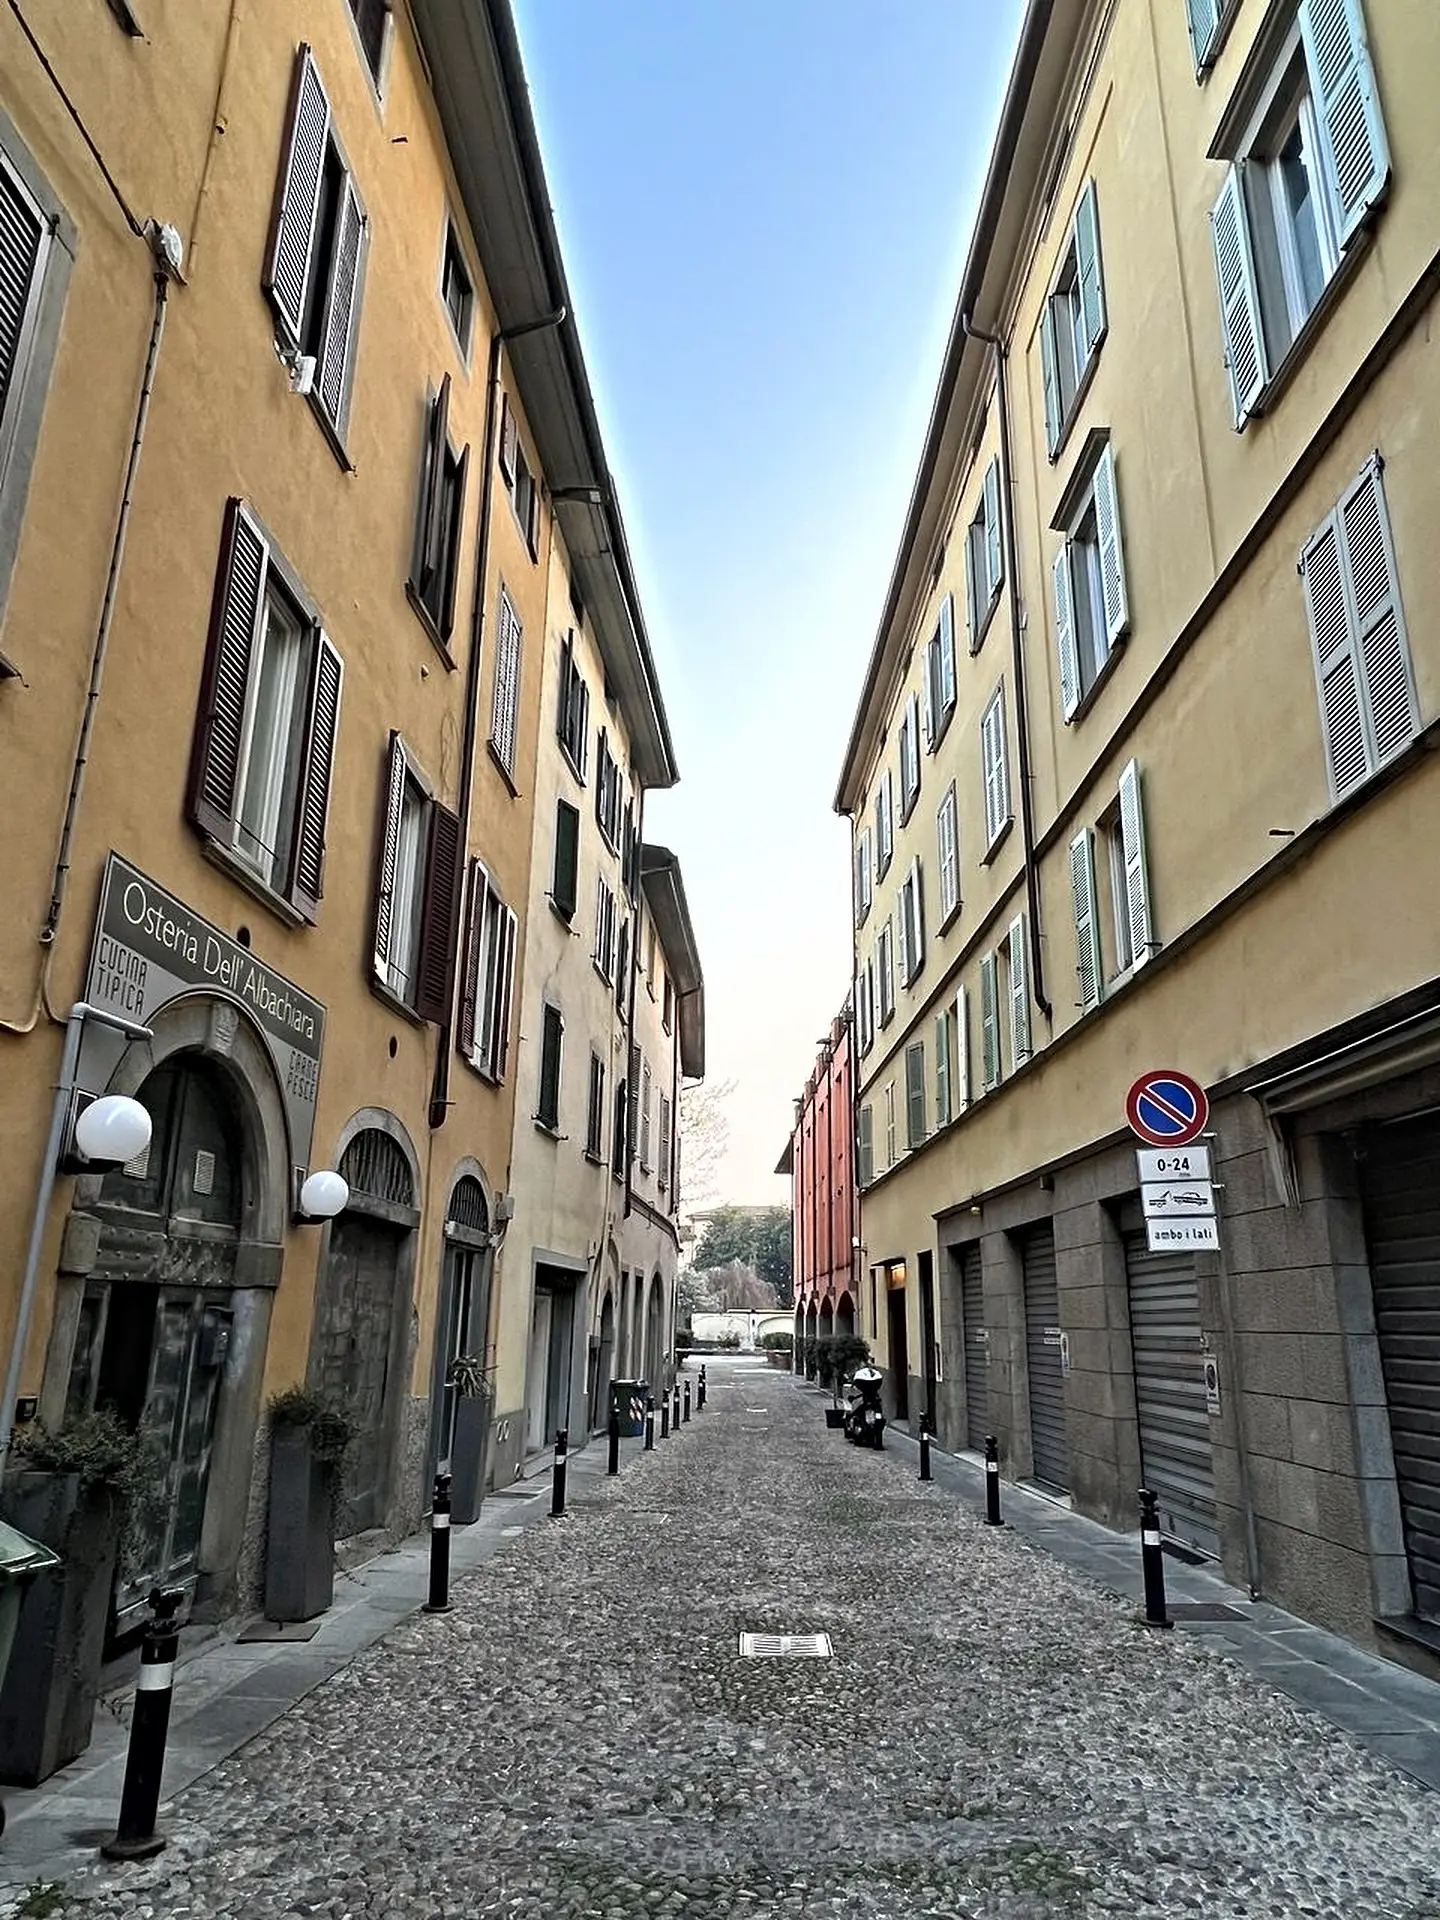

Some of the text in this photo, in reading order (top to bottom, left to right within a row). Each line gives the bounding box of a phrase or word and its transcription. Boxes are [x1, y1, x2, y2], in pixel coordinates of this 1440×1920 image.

[99, 937, 147, 987] CUCINA
[124, 882, 314, 1039] Osteria Dell' Albachiara
[97, 967, 144, 1016] TIPICA
[1157, 1157, 1190, 1171] 0-24
[1154, 1228, 1183, 1239] ambo
[1192, 1228, 1213, 1239] lati
